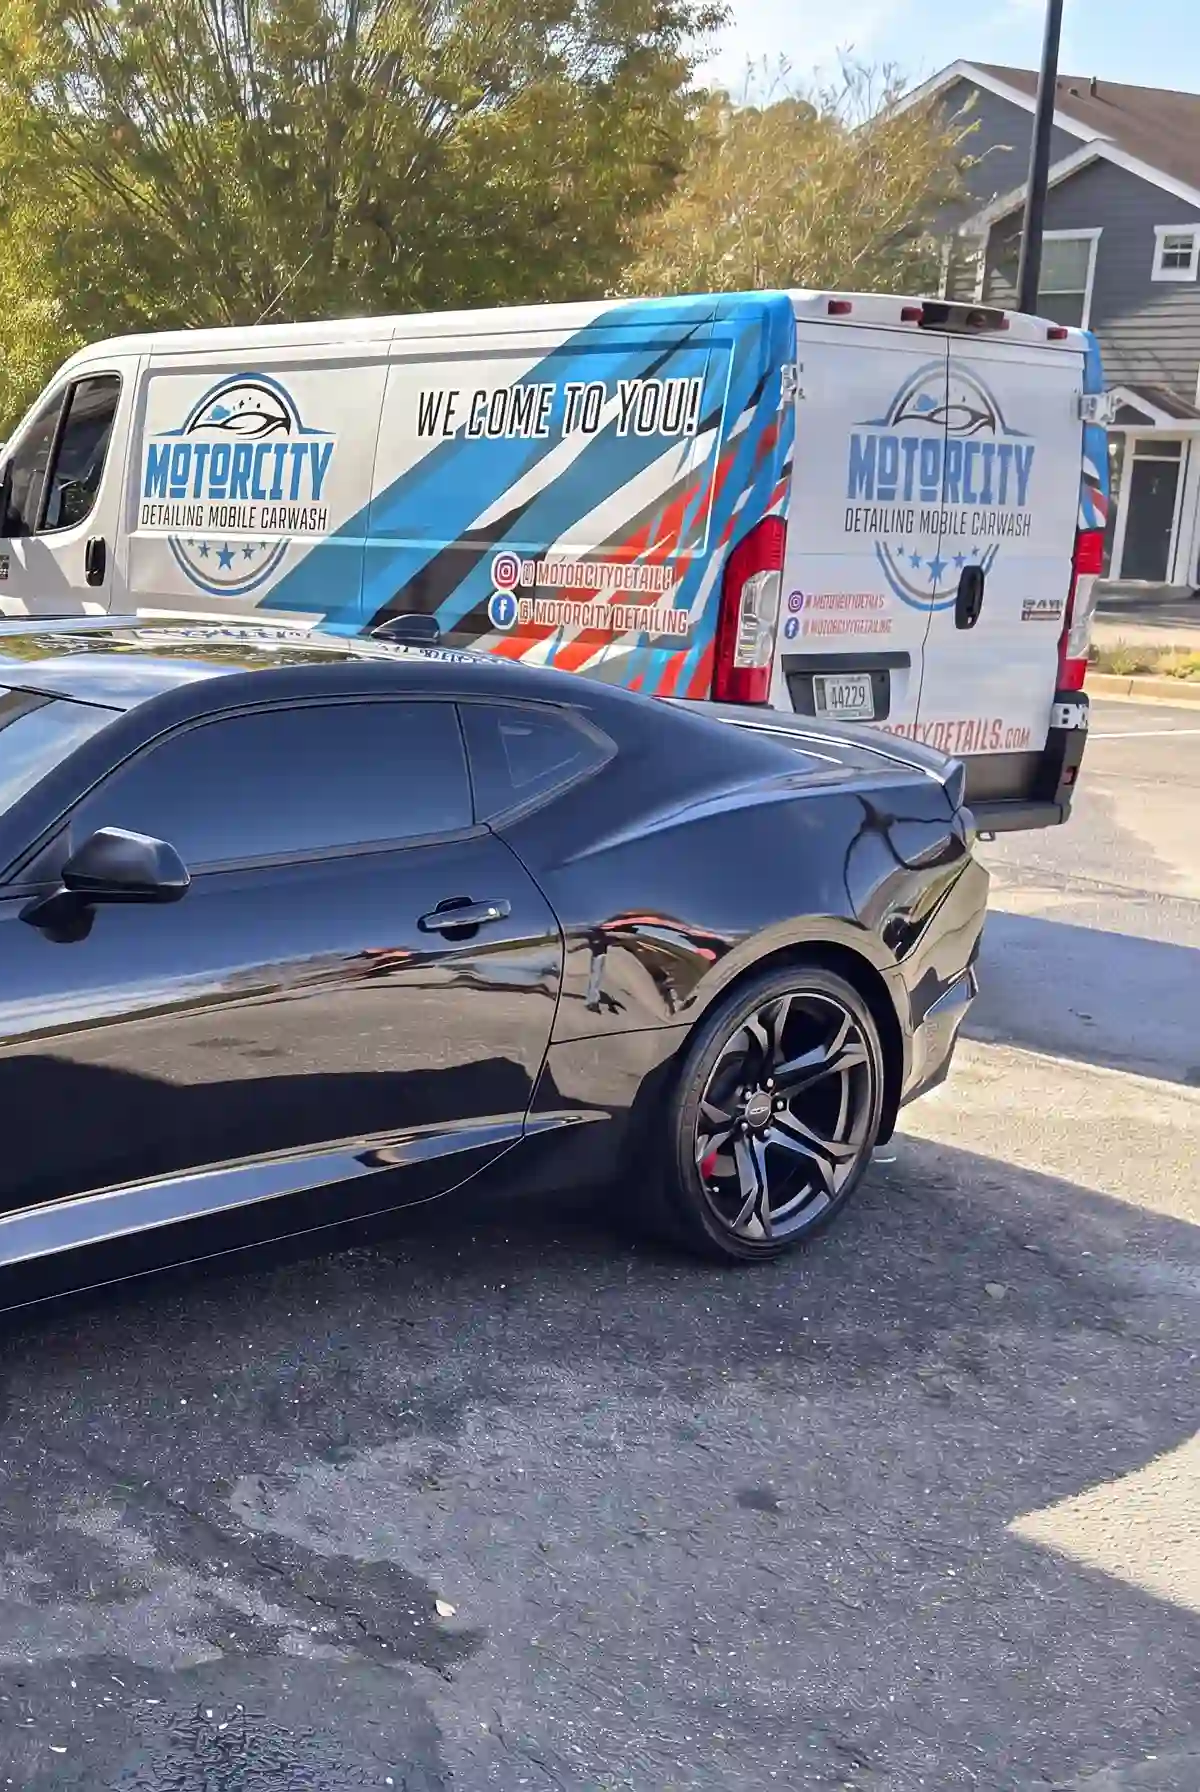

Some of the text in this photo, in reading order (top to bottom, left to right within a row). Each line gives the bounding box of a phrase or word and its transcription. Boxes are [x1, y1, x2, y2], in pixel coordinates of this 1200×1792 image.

[417, 379, 701, 437] WE COME TO YOU!
[143, 442, 335, 501] MOTORCITY
[846, 433, 1035, 507] MOTORCITY
[141, 504, 328, 531] DETAILING MOBILE CARWASH
[844, 507, 1032, 538] DETAILING MOBILE CARWASH
[536, 601, 688, 633] MOTORCITYDETAILING
